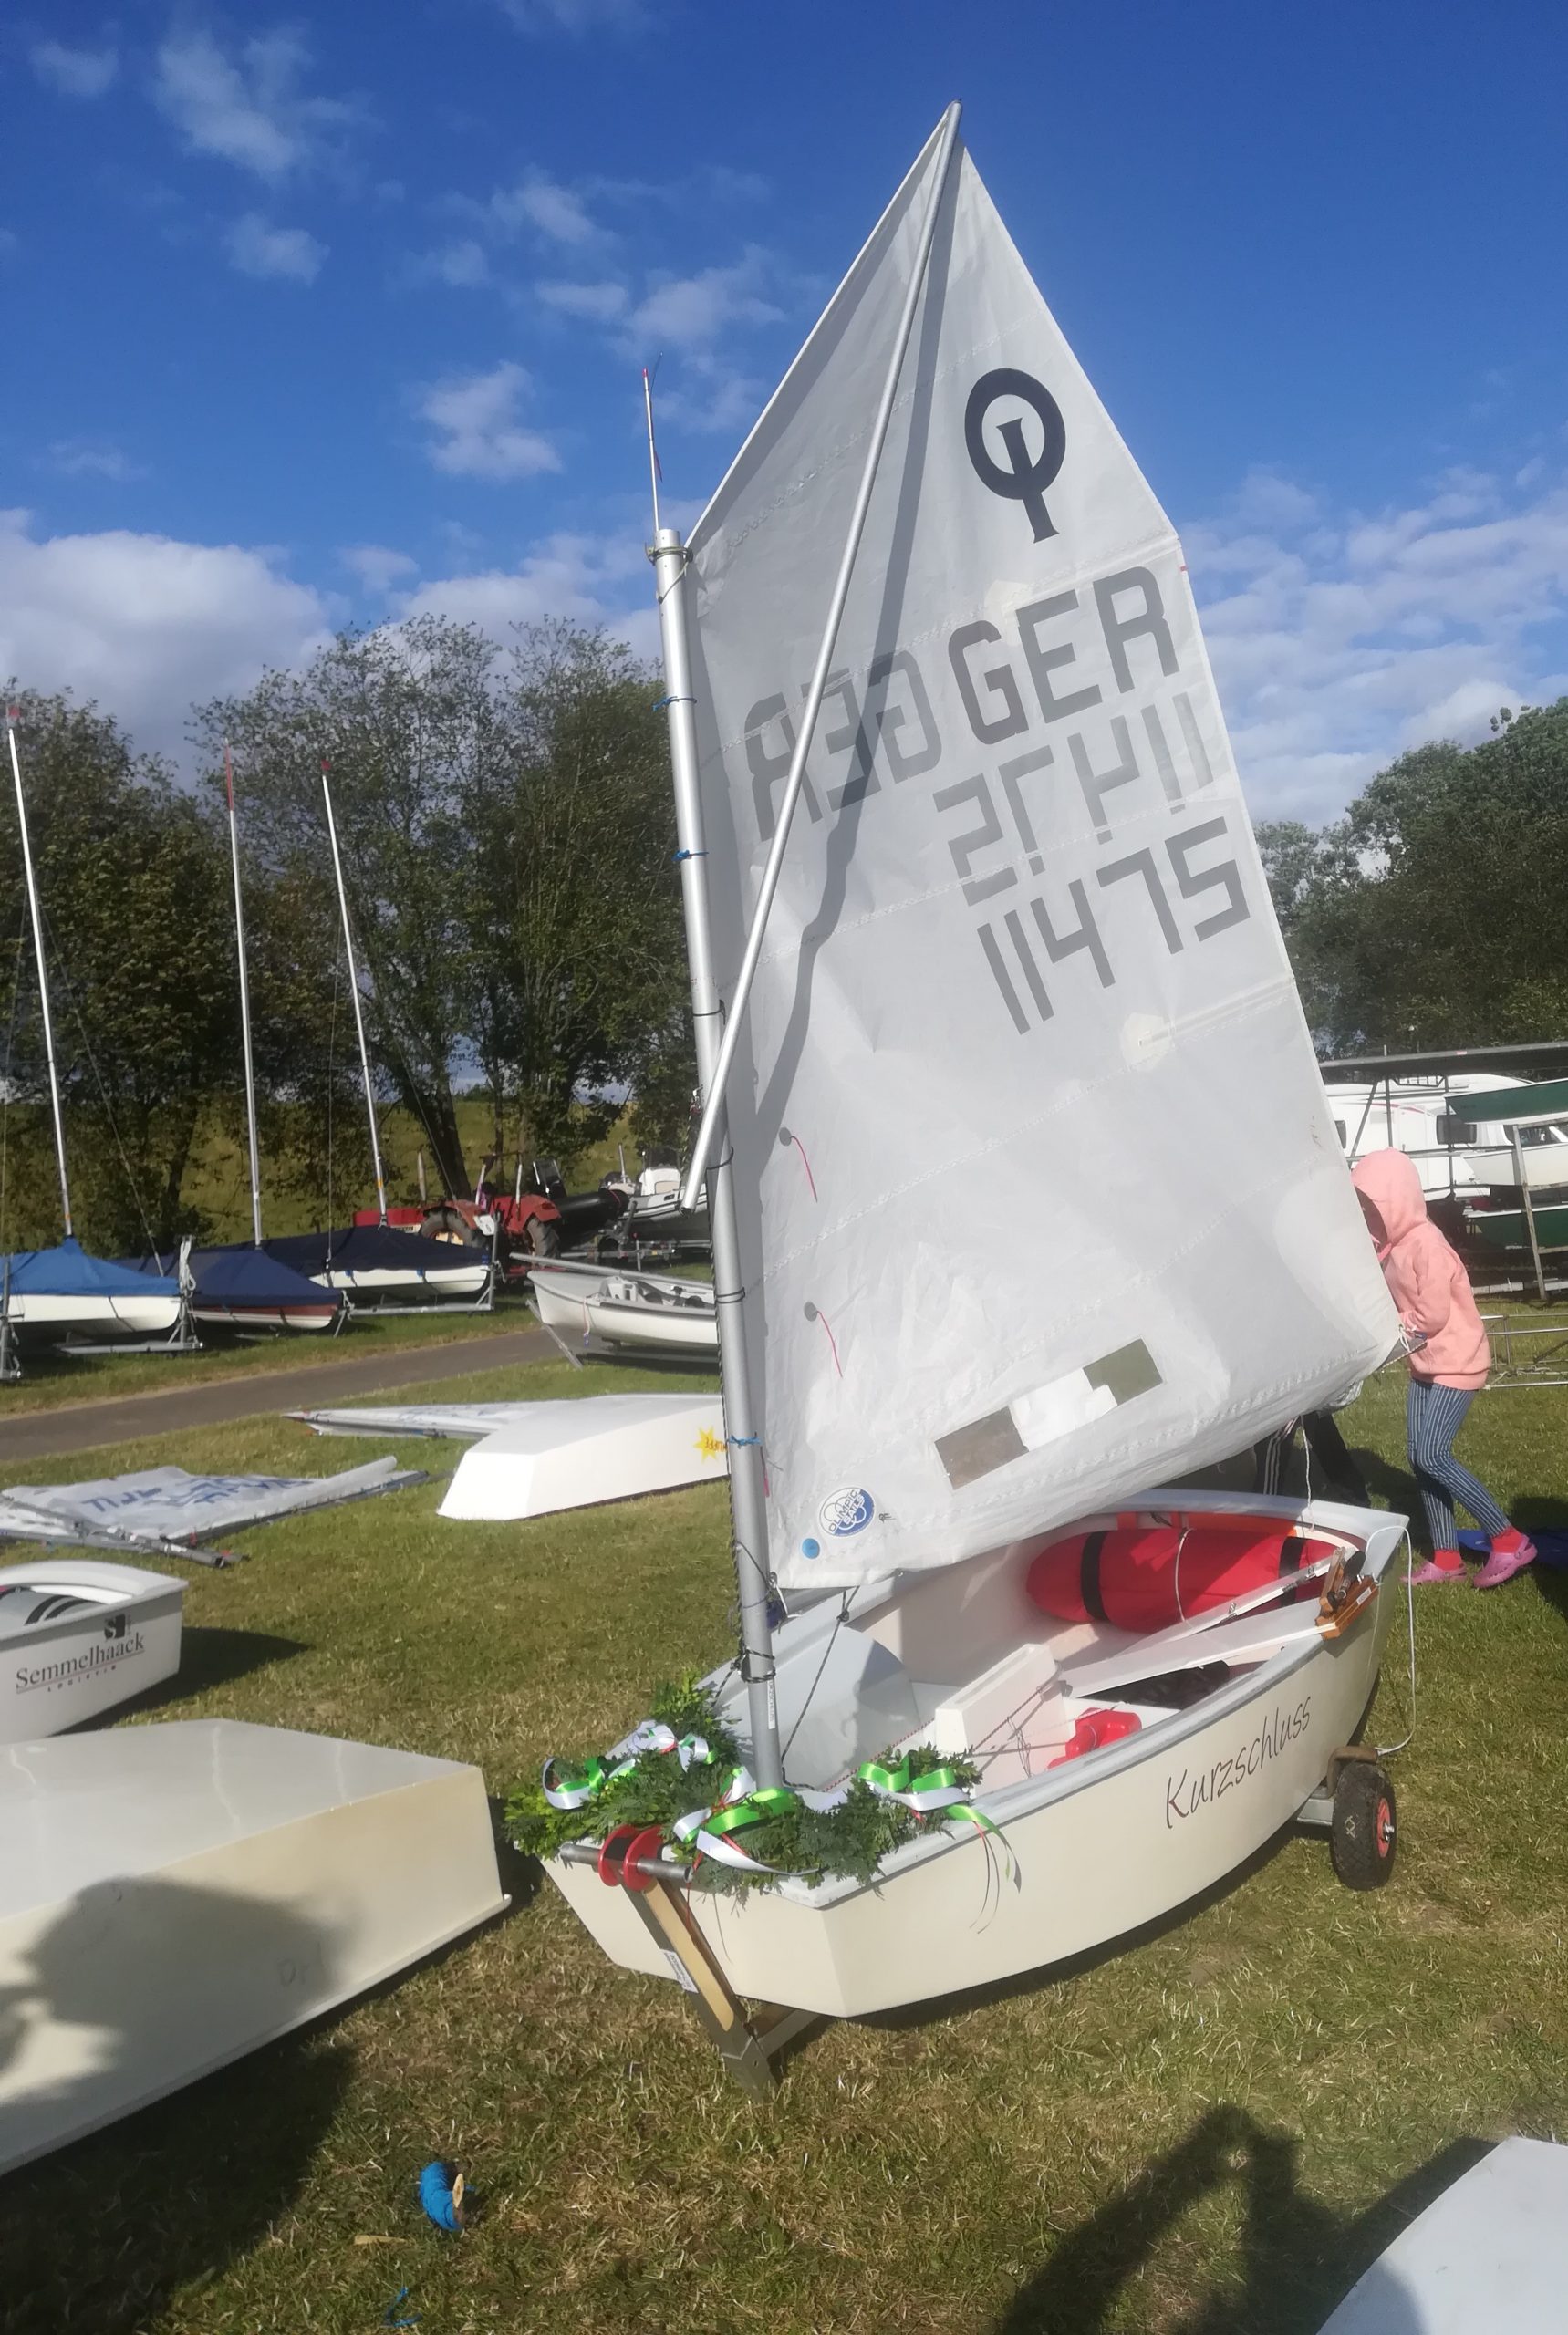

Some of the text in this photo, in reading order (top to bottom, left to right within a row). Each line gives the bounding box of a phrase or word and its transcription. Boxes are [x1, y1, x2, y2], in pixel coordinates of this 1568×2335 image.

[948, 566, 1180, 745] GER
[976, 816, 1251, 1035] 11475
[828, 1489, 857, 1532] OLIMPIC
[843, 1495, 865, 1525] SAILS
[16, 1631, 144, 1688] Semmelhaack
[1166, 1696, 1311, 1829] Kurzschluss
